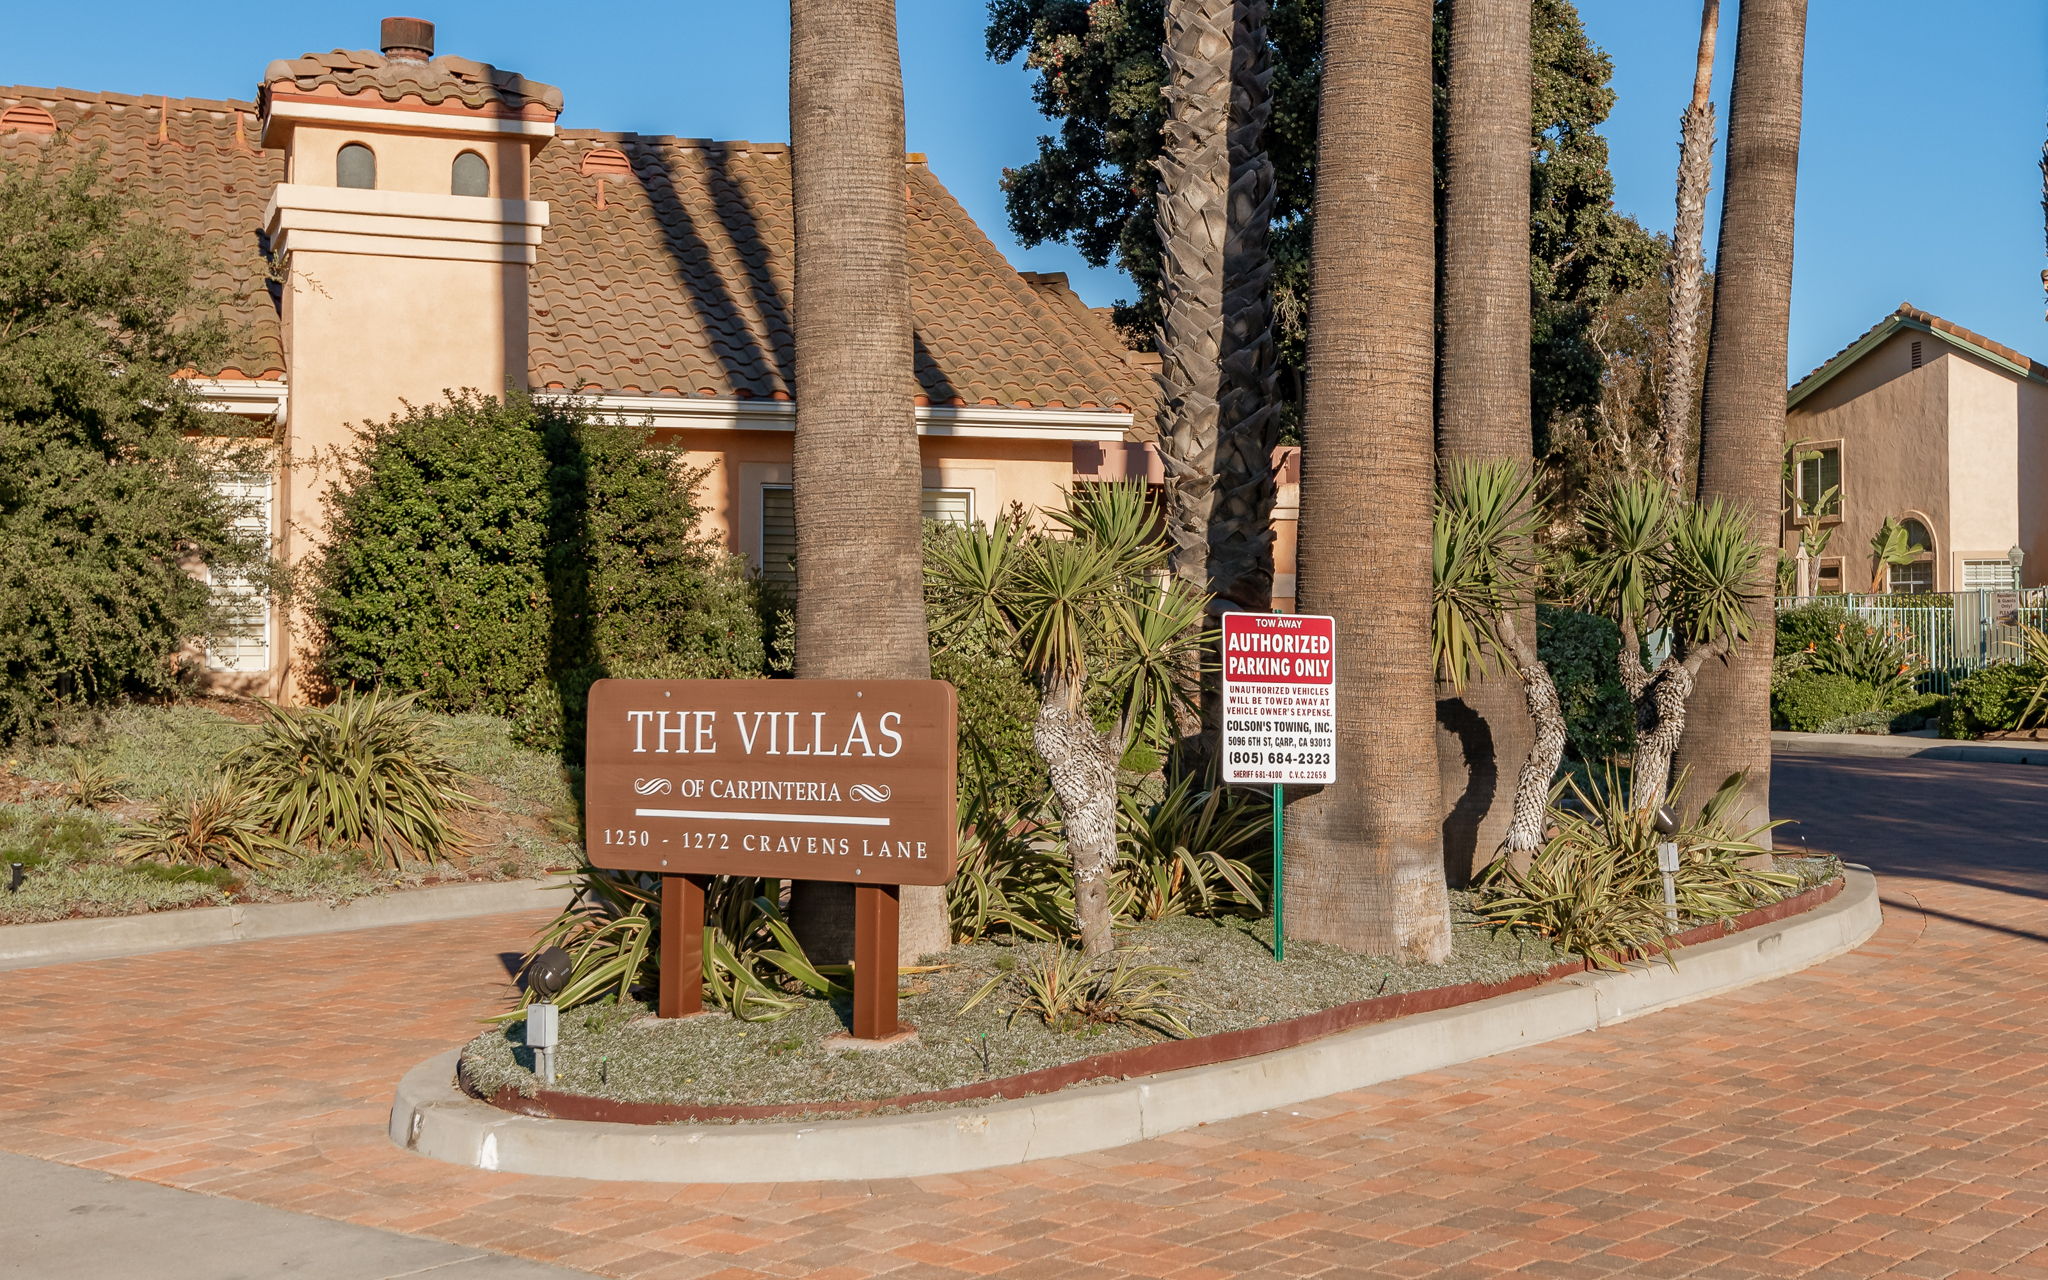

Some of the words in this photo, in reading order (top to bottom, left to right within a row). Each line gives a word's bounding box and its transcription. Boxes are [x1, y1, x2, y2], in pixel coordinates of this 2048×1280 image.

[1256, 618, 1275, 628] TOW
[1278, 619, 1302, 628] AWAY
[1229, 633, 1330, 654] AUTHORIZED
[1230, 656, 1290, 676] PARKING
[1295, 659, 1330, 677] ONLY
[1230, 686, 1289, 694] UNAUTHORIZED
[1293, 687, 1329, 696] VEHICLES
[1227, 707, 1258, 715] VEHICLE
[1260, 708, 1294, 716] OWNER'S
[1297, 708, 1332, 717] EXPENSE.
[1227, 720, 1271, 732] COLSON'S
[1274, 722, 1312, 734] TOWING,
[1314, 722, 1332, 733] INC.
[628, 710, 717, 754] THE
[733, 711, 903, 758] VILLAS
[1228, 736, 1245, 746] 5096
[1248, 737, 1261, 746] 6TH
[1263, 737, 1273, 748] ST,
[1299, 738, 1308, 747] CA
[1310, 738, 1331, 747] 93013
[1229, 752, 1263, 765] (805)
[1268, 753, 1330, 764] 684-2323
[1233, 770, 1254, 778] SHERIFF
[681, 778, 705, 798] OF
[710, 778, 842, 802] CARPINTERIA
[603, 828, 650, 848] 1250
[682, 832, 730, 850] 1272
[742, 834, 849, 856] CRAVENS
[862, 839, 928, 859] LANE
